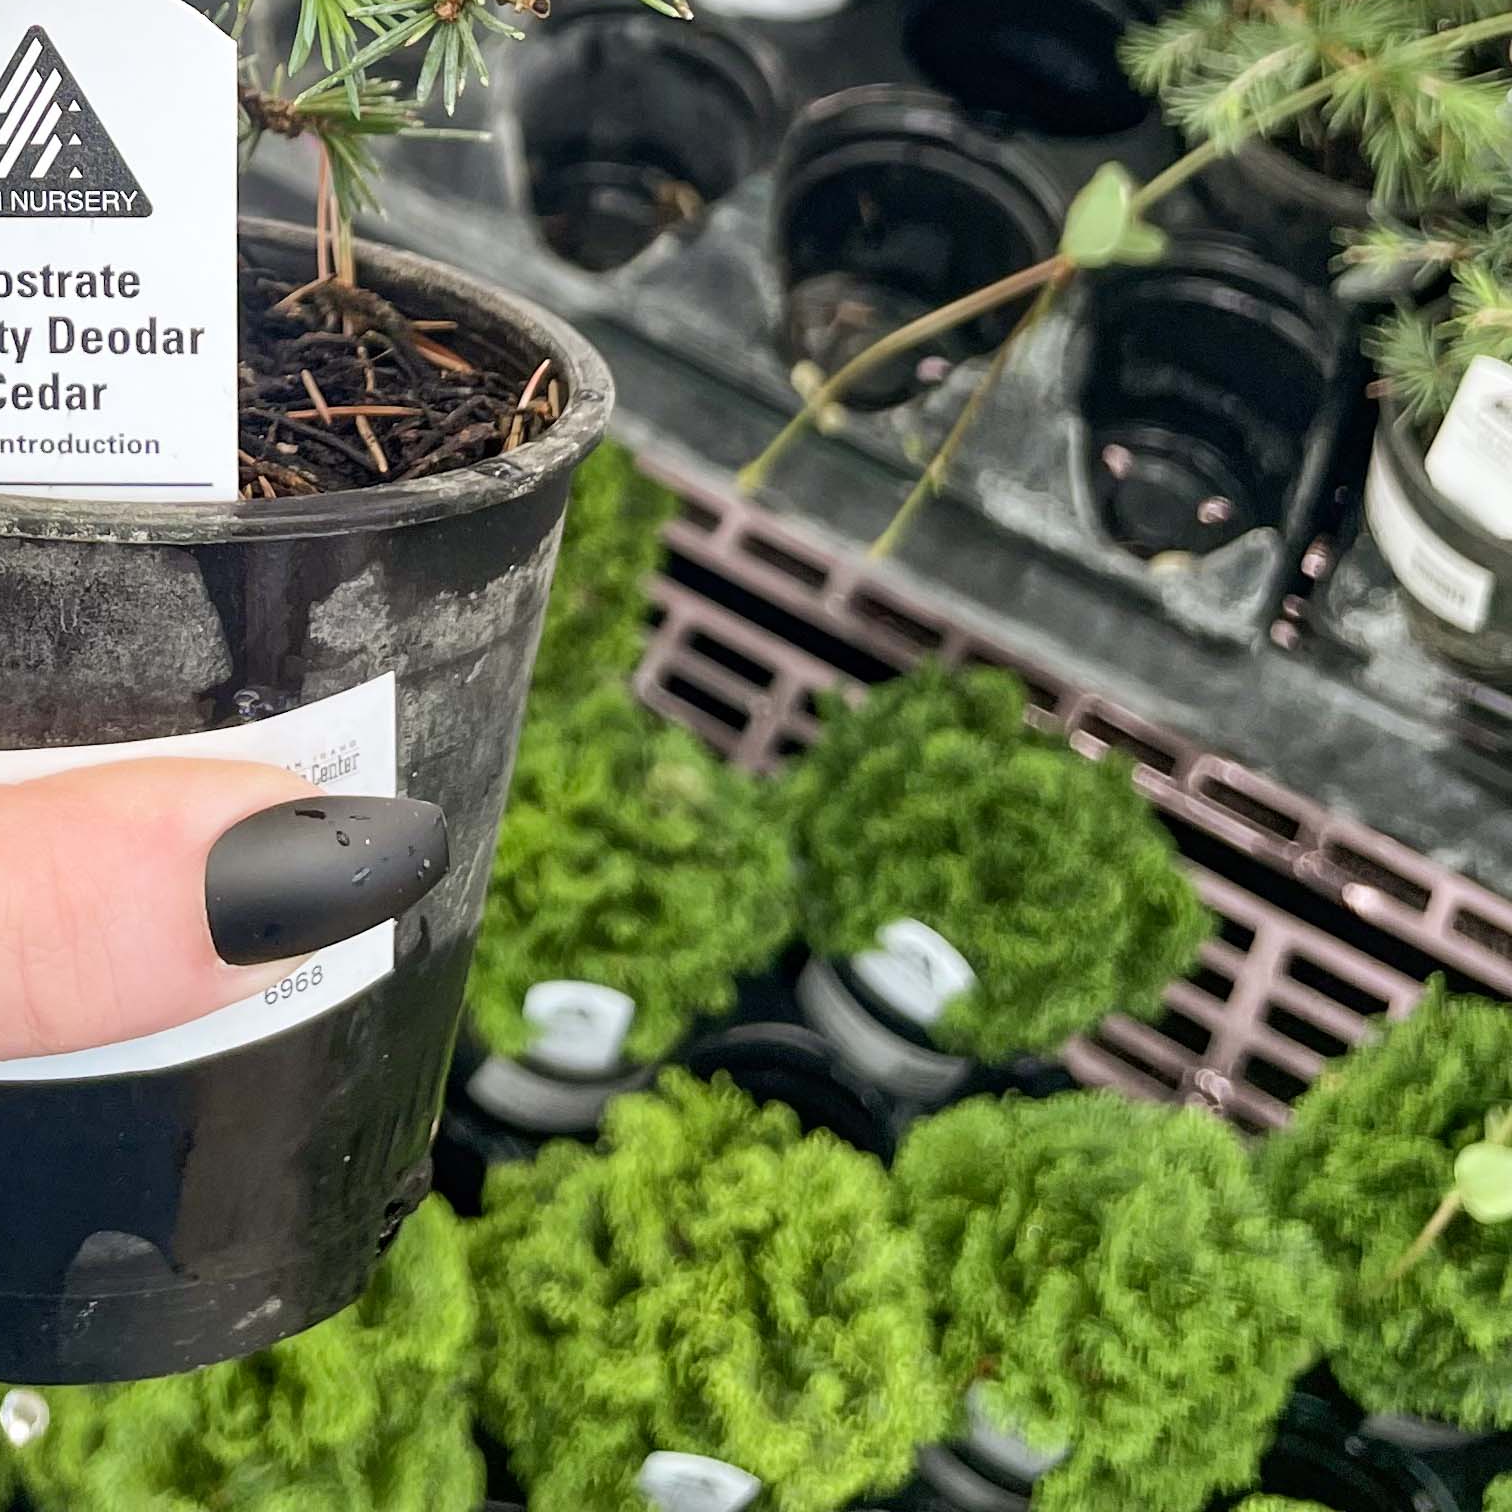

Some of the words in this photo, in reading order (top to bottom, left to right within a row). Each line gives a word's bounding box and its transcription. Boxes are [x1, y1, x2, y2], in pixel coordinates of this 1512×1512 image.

[10, 190, 138, 212] NURSERY
[48, 316, 206, 355] Deodar
[311, 752, 360, 786] Center
[264, 965, 323, 1005] 6968
